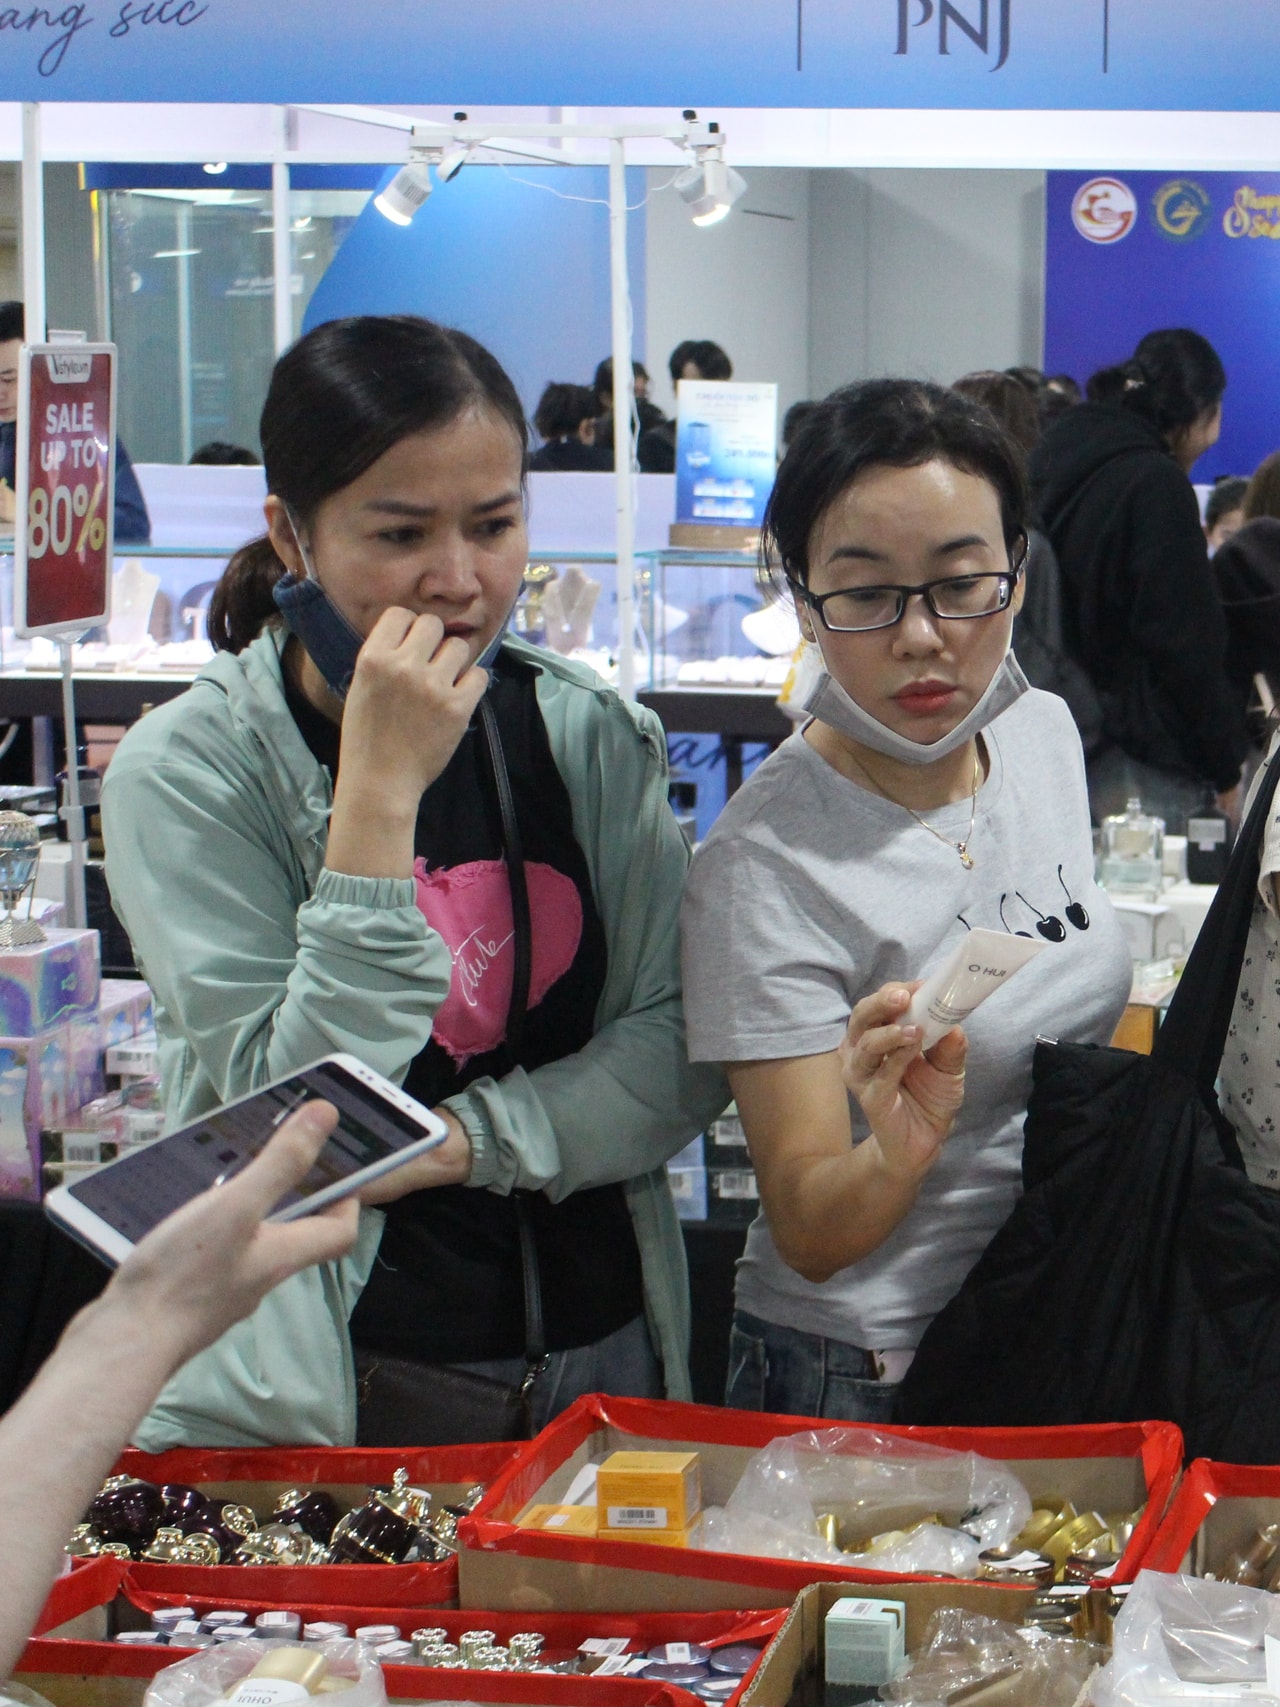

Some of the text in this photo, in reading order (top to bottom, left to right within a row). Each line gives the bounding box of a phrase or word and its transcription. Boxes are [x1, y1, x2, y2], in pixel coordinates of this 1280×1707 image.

[893, 0, 1010, 73] PNJ
[46, 402, 94, 435] SALE
[41, 438, 97, 472] UP TO
[29, 483, 106, 559] 80%
